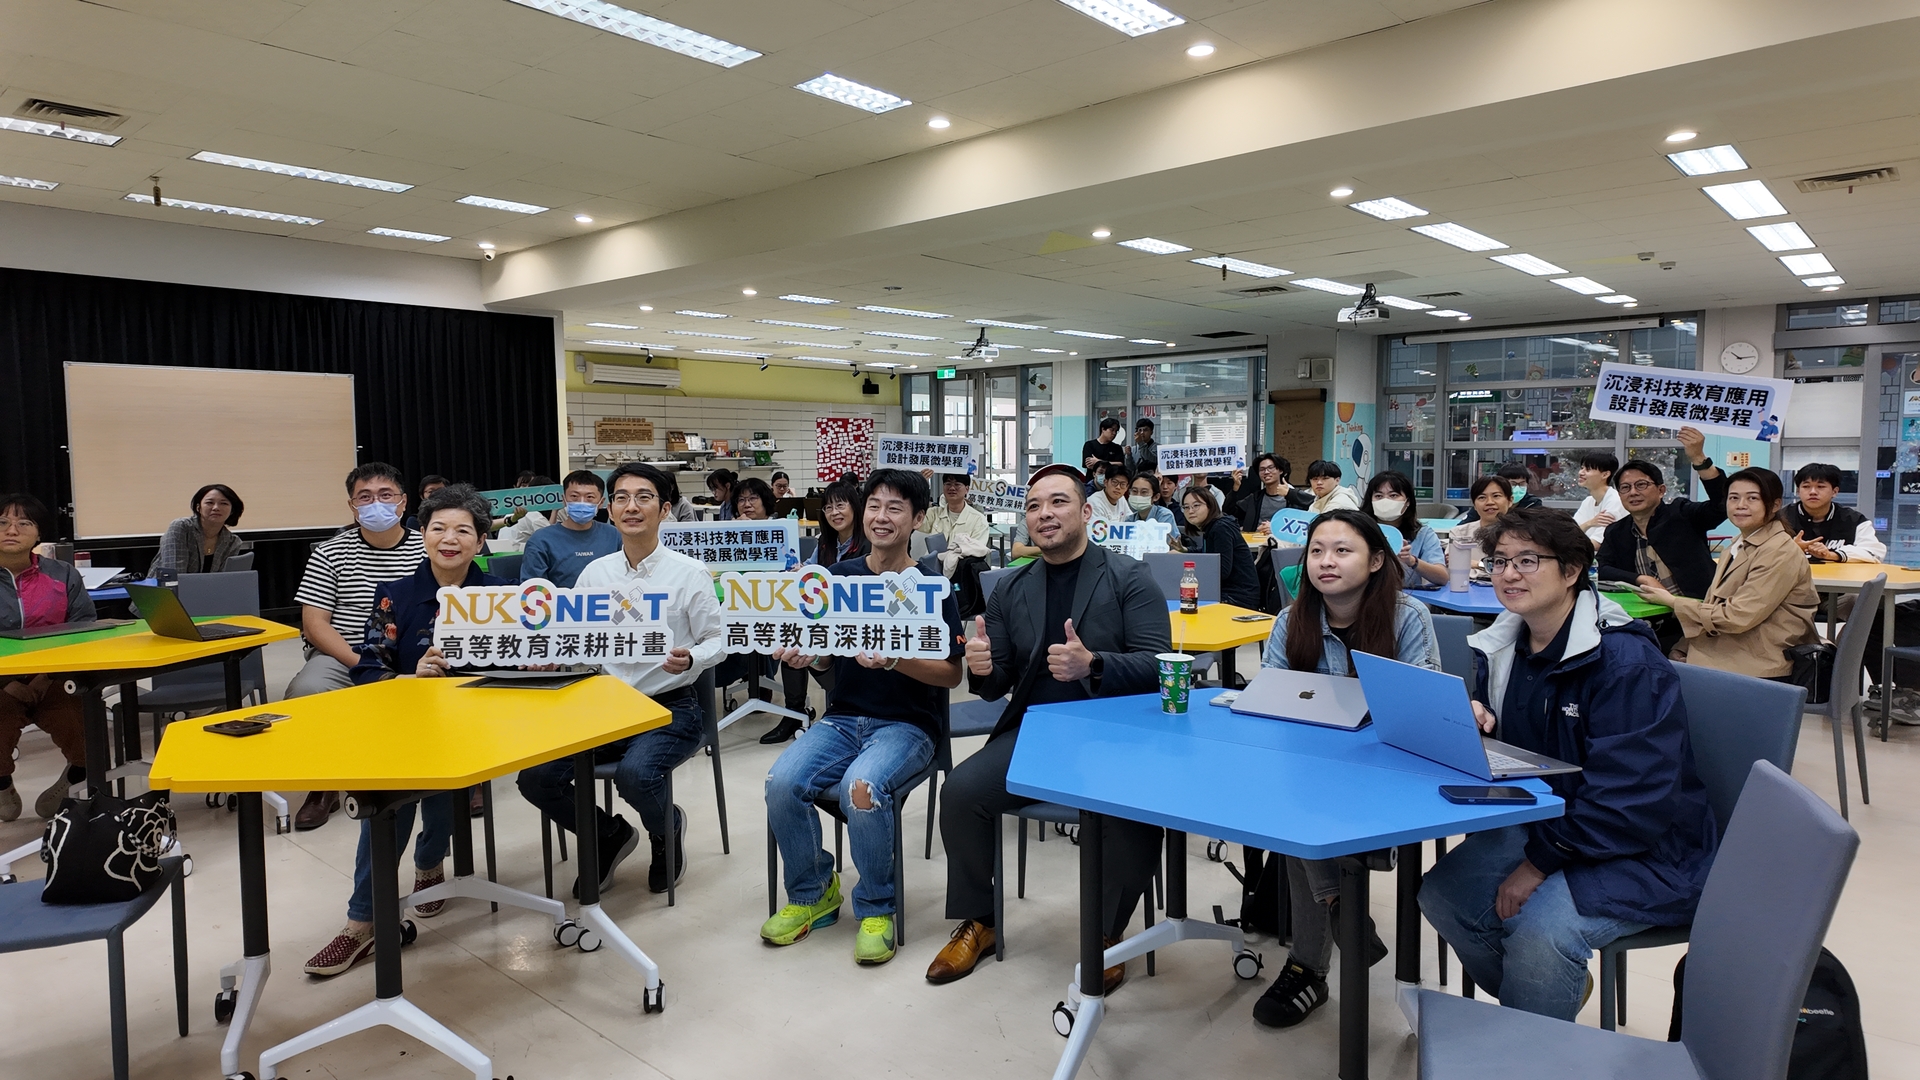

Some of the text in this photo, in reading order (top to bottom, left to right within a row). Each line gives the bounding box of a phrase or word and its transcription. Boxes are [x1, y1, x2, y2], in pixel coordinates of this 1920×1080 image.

[1603, 373, 1770, 408] 沉浸科技教育應用
[1608, 394, 1753, 428] 設計發展微學程
[882, 440, 970, 456] 沉浸科技教育應用
[1160, 446, 1237, 460] 沉浸科技教育應用
[886, 453, 963, 468] 設計發展微學程
[1165, 457, 1232, 470] 設計發展微學程
[504, 492, 564, 508] SCHOOL
[663, 529, 785, 547] 沉浸科技教育應用
[440, 631, 668, 660] 高等教育深耕計畫
[726, 621, 943, 653] 高等教育深耕計畫
